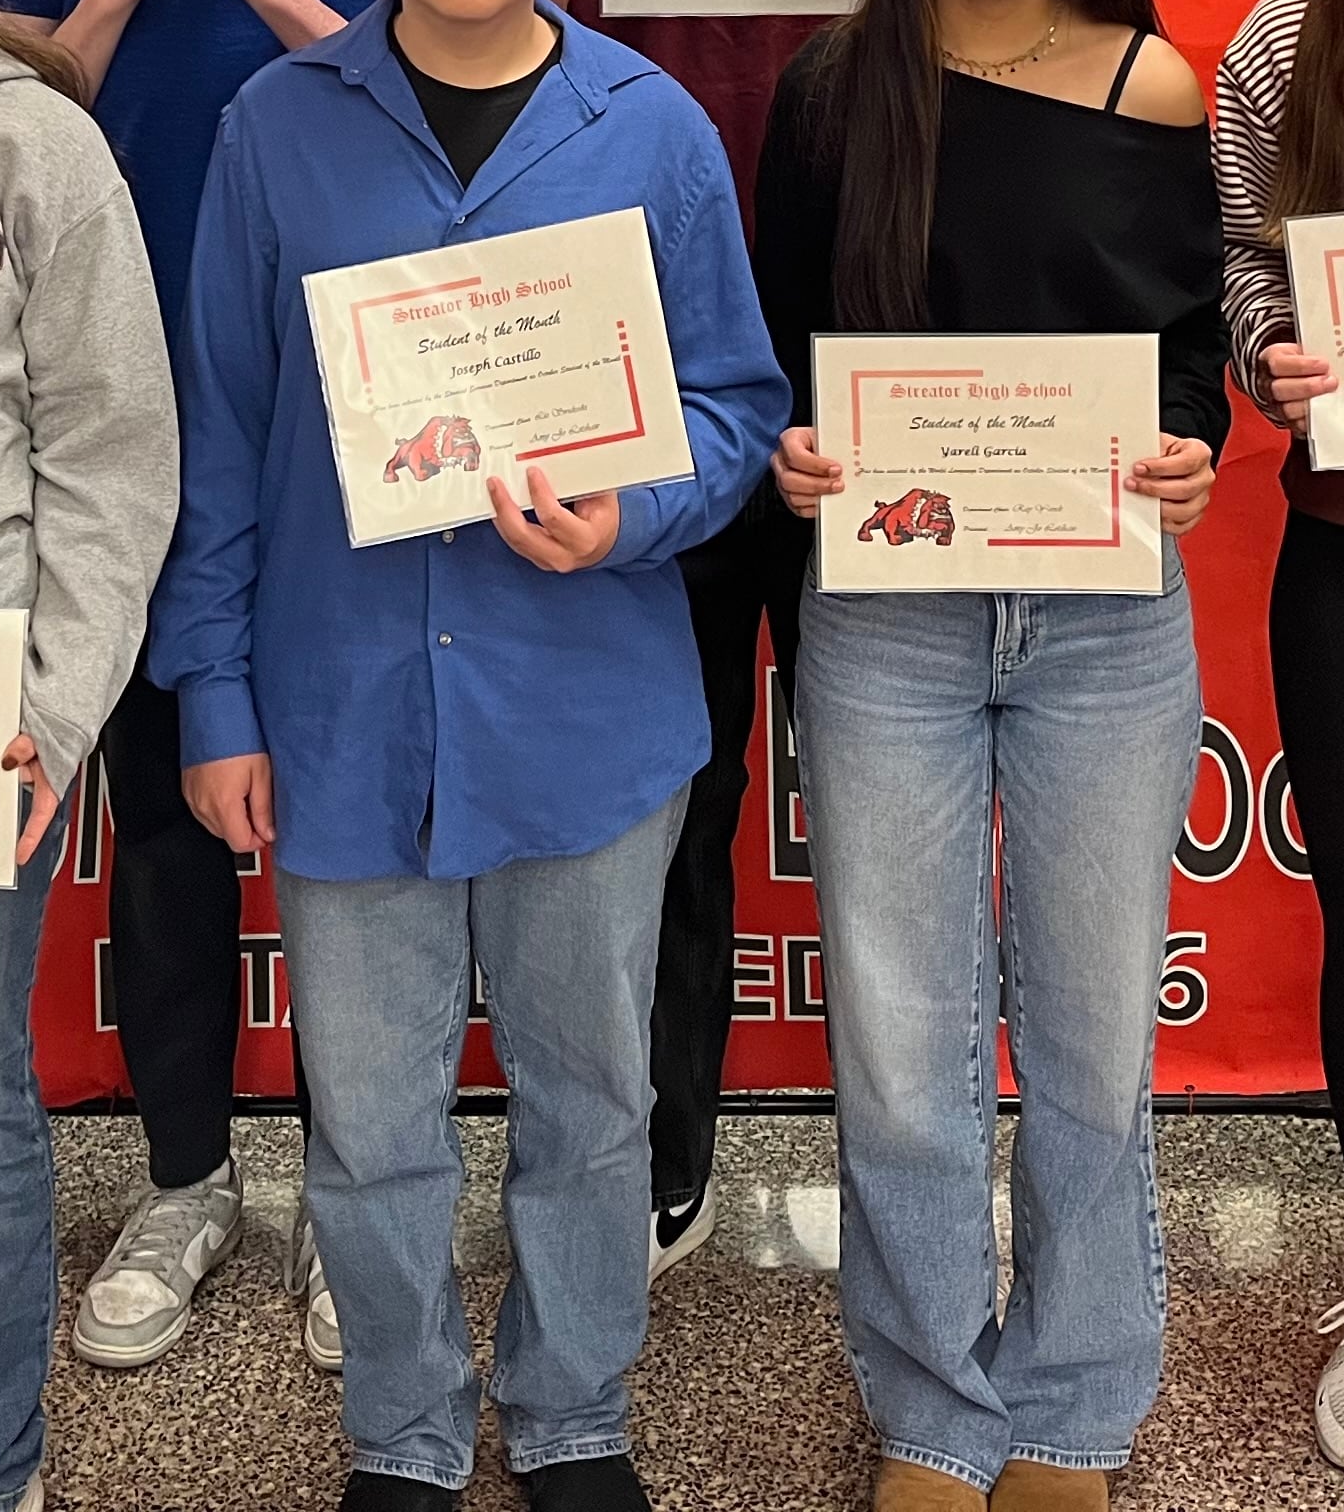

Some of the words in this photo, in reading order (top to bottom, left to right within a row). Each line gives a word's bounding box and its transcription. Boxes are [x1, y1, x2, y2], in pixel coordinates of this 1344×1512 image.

[392, 297, 462, 324] Streator
[469, 287, 510, 309] High
[515, 273, 572, 298] School
[417, 332, 470, 354] Student
[475, 330, 487, 344] of
[494, 322, 512, 337] the
[516, 310, 560, 332] Month
[450, 355, 491, 379] Joseph
[495, 349, 541, 369] Castillo
[890, 384, 959, 399] Streator
[968, 383, 1009, 400] High
[1015, 383, 1071, 399] School
[909, 417, 963, 429] Student
[968, 417, 981, 432] of
[987, 416, 1005, 428] the
[1011, 416, 1055, 429] Month
[941, 446, 979, 457] Yarell
[984, 447, 1026, 456] Garcia
